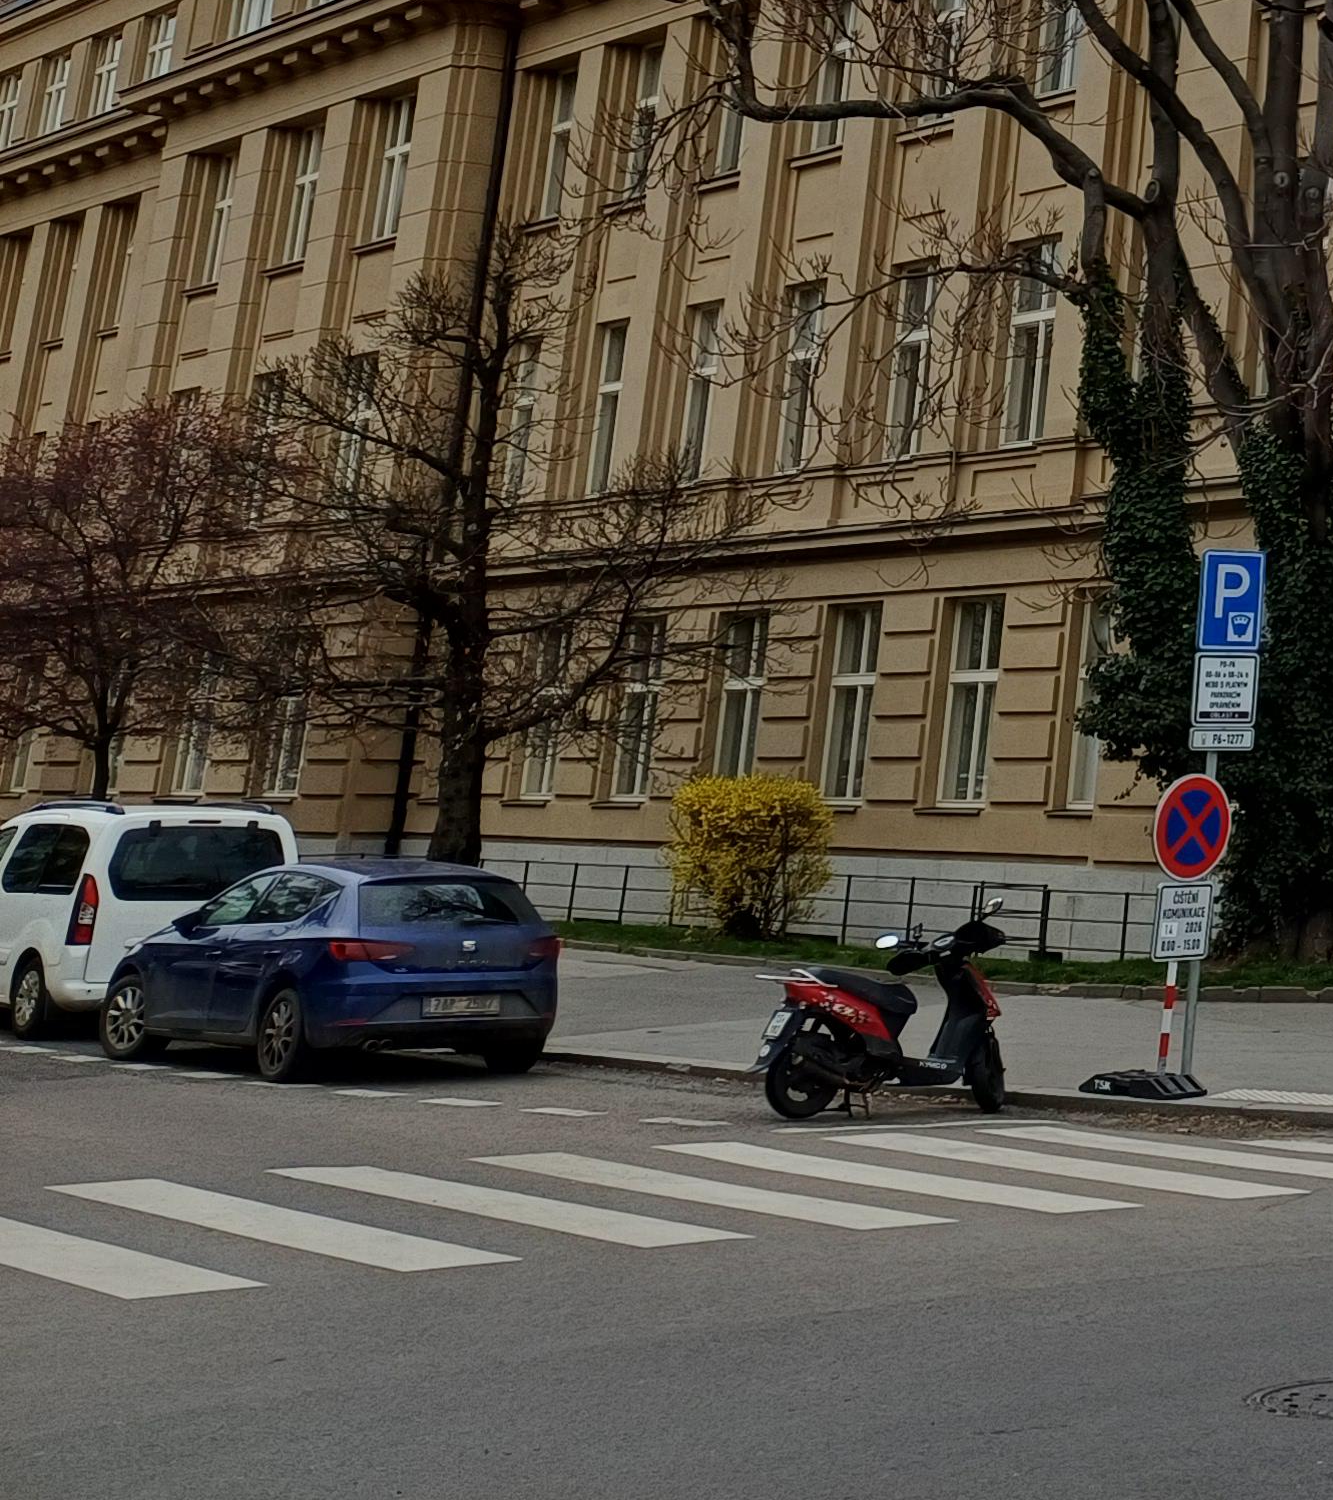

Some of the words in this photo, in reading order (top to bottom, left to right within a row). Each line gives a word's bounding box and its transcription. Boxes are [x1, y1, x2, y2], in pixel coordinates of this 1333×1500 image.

[1214, 563, 1251, 619] P
[1212, 734, 1244, 744] P6-1277
[1094, 1079, 1112, 1091] TSK
